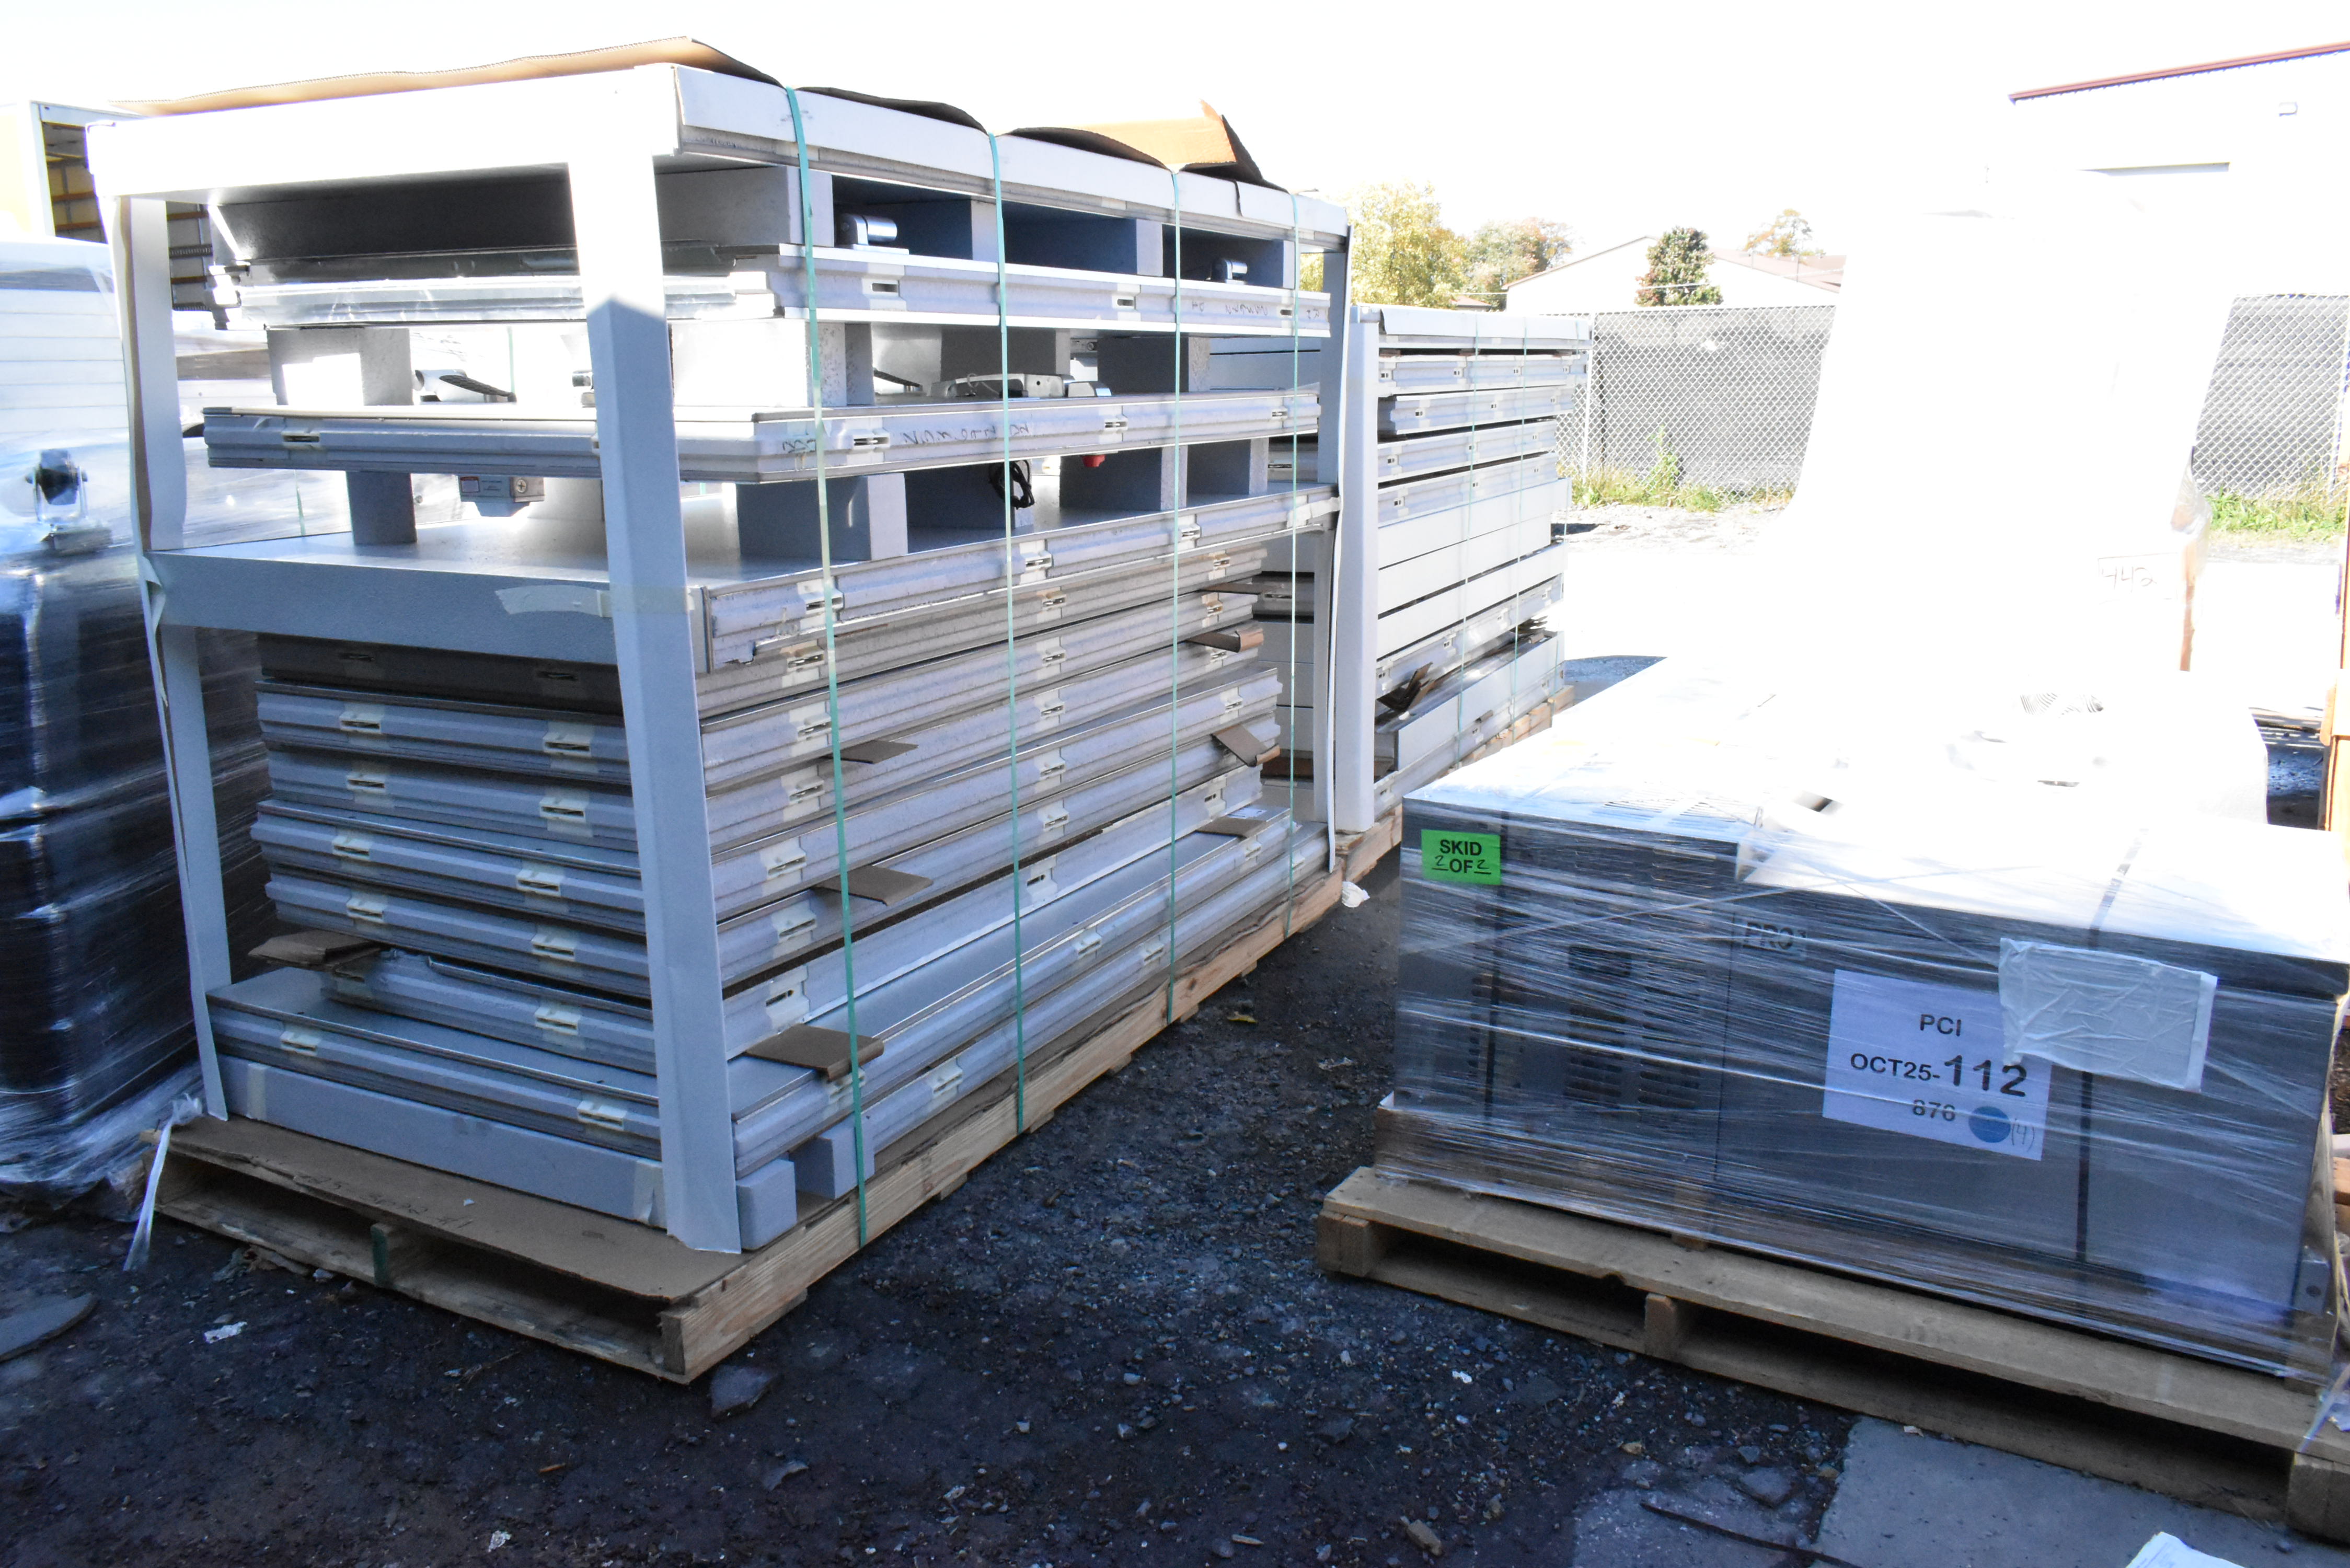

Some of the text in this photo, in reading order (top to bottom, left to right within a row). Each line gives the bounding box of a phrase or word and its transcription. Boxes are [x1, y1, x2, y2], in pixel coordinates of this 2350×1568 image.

[2101, 566, 2157, 593] 442
[1439, 839, 1482, 856] SKID
[1435, 855, 1489, 873] 2 OF 2
[1919, 1013, 1962, 1037] PCI
[1850, 1053, 2027, 1097] OCT25-112
